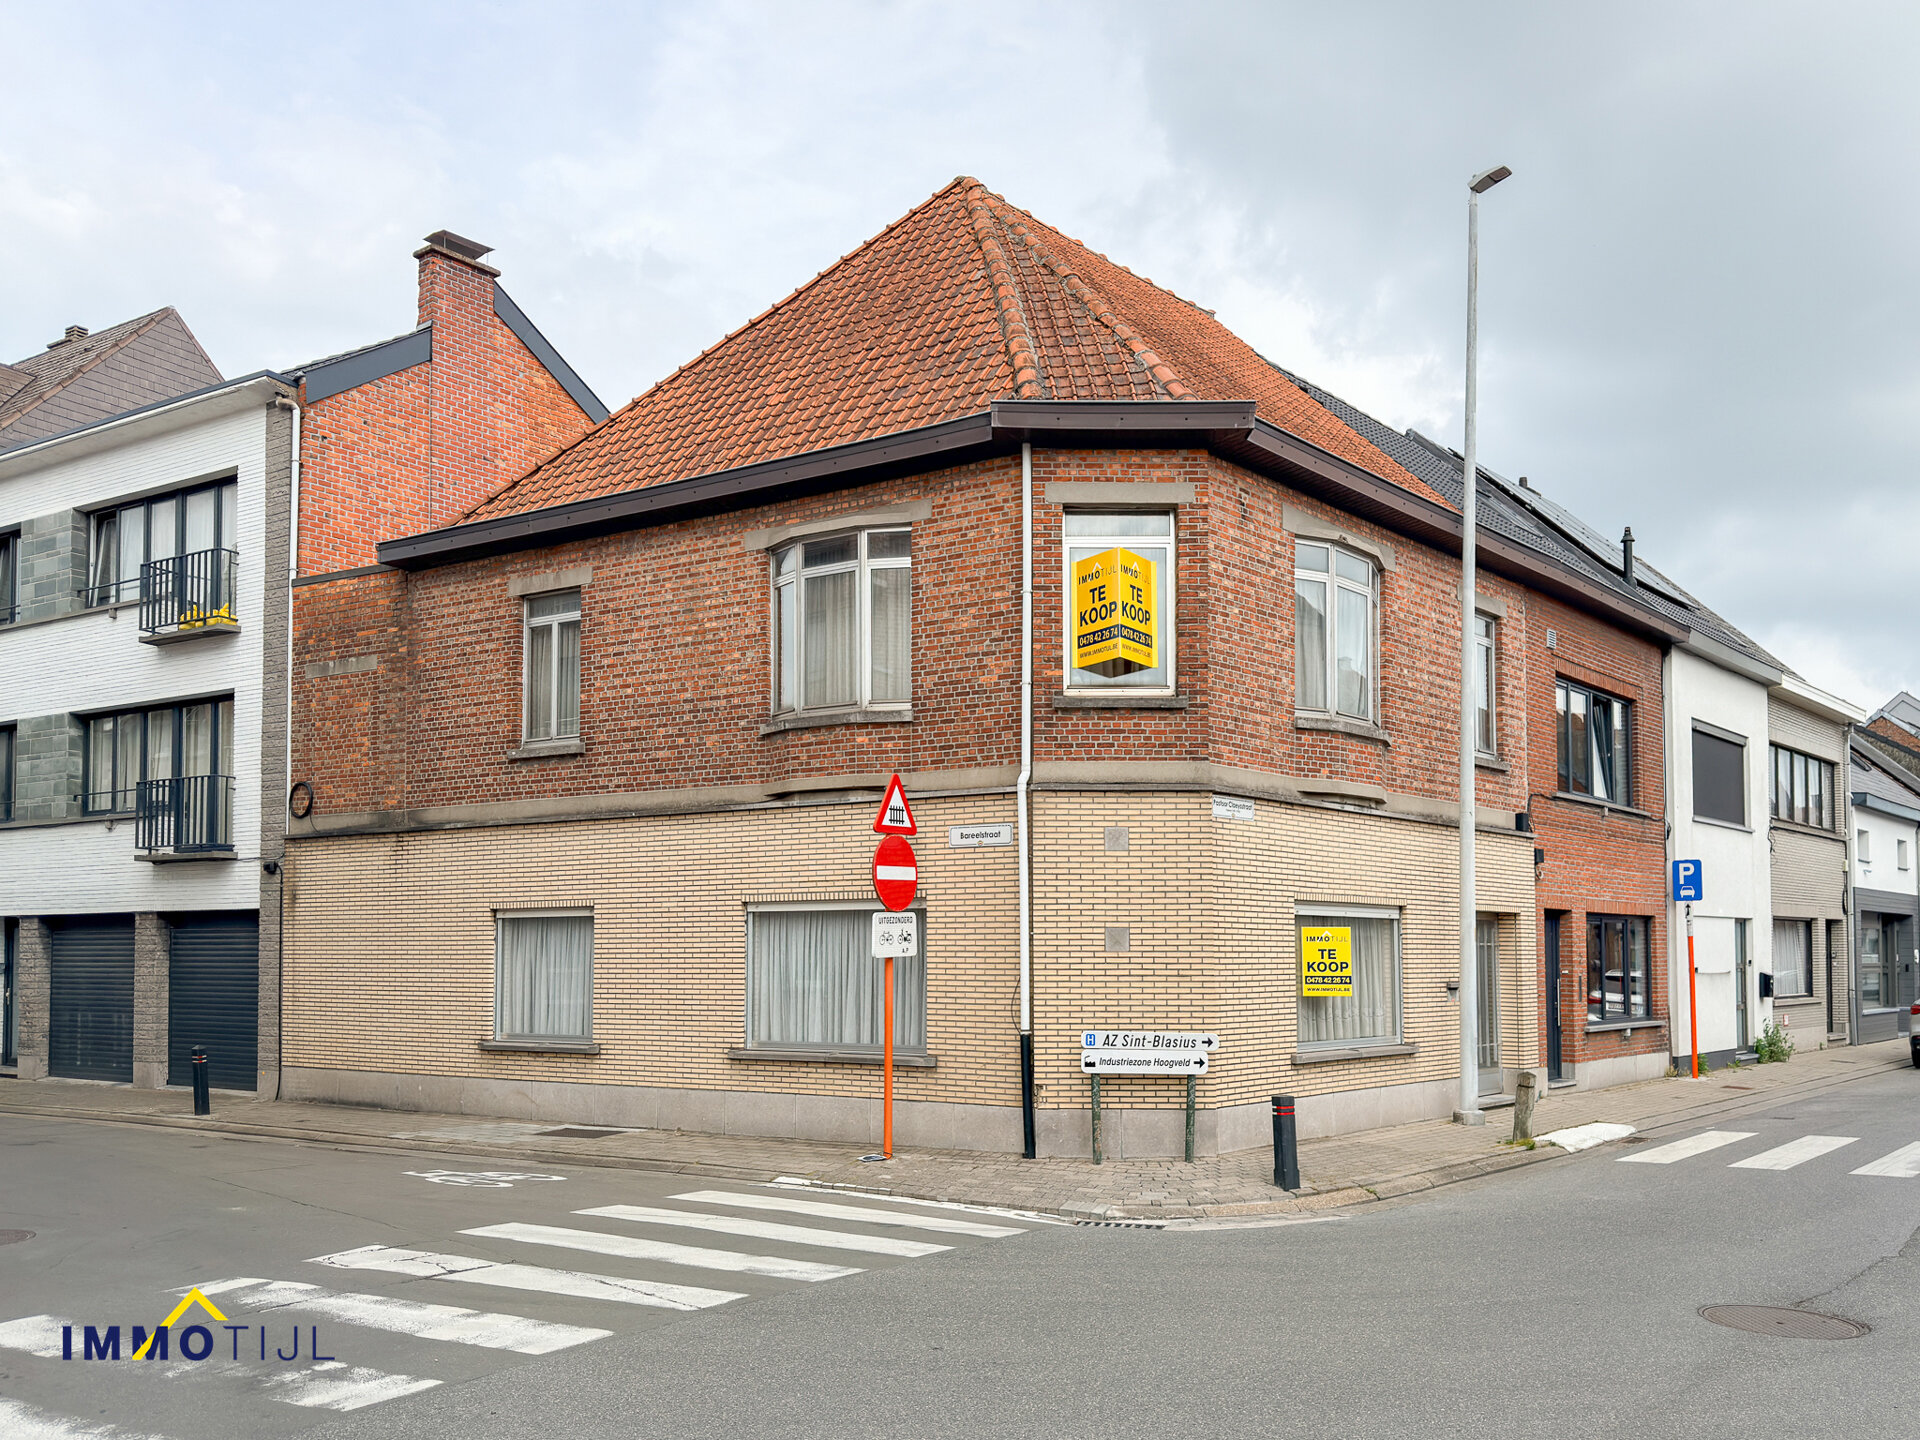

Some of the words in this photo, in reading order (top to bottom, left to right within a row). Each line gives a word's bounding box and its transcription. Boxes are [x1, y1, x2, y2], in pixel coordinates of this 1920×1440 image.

[1078, 564, 1118, 585] IMMOTIJL
[1089, 584, 1107, 604] TE
[1129, 584, 1143, 604] TE
[1079, 601, 1118, 627] KOOP
[1121, 601, 1151, 626] KOOP
[1079, 633, 1094, 646] 0478
[1094, 631, 1102, 641] 42
[1102, 629, 1110, 640] 26
[1110, 627, 1118, 637] 74
[1121, 628, 1133, 640] 0478
[1133, 631, 1140, 641] 42
[960, 831, 1001, 840] Bareelstraat
[1679, 862, 1695, 885] P
[878, 916, 913, 924] UITGEZONDERD
[1317, 948, 1337, 960] TE
[1307, 961, 1349, 973] KOOP
[1086, 1034, 1096, 1046] H
[1102, 1034, 1118, 1047] AZ
[1121, 1034, 1197, 1048] Sint-Blasius
[1099, 1057, 1152, 1067] Industriezone
[1153, 1058, 1191, 1069] Hoogveld
